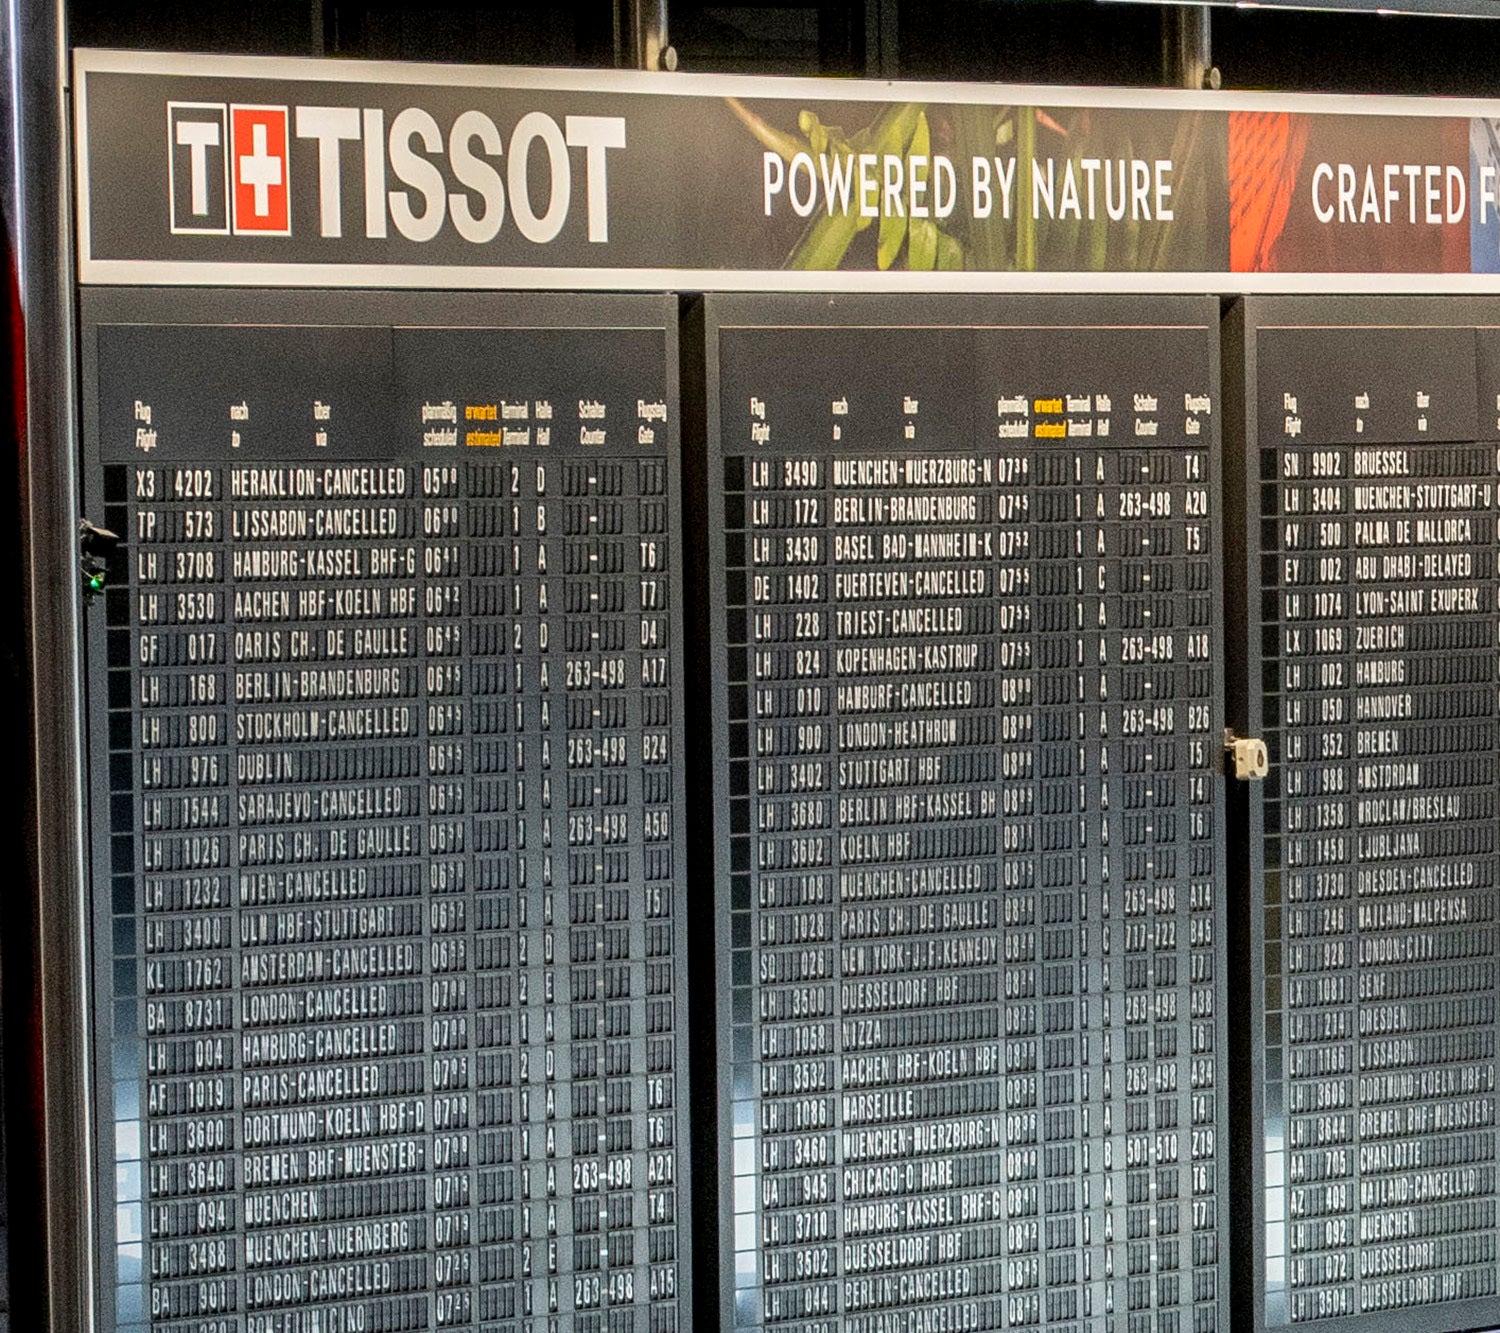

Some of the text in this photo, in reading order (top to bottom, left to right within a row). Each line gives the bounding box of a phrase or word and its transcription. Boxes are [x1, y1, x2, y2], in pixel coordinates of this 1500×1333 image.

[295, 105, 628, 245] TISSOT
[763, 151, 1175, 226] POWERED BY NATURE
[1310, 161, 1467, 225] CRAFTED
[136, 468, 406, 497] X3 4202 HERAKLION-CANCELLED
[141, 676, 160, 703] LH
[189, 674, 216, 701] 168
[235, 668, 401, 699] BERLIN-BRANDENBURG
[539, 662, 549, 688] A
[565, 659, 626, 687] 263-498
[641, 657, 666, 684] A17
